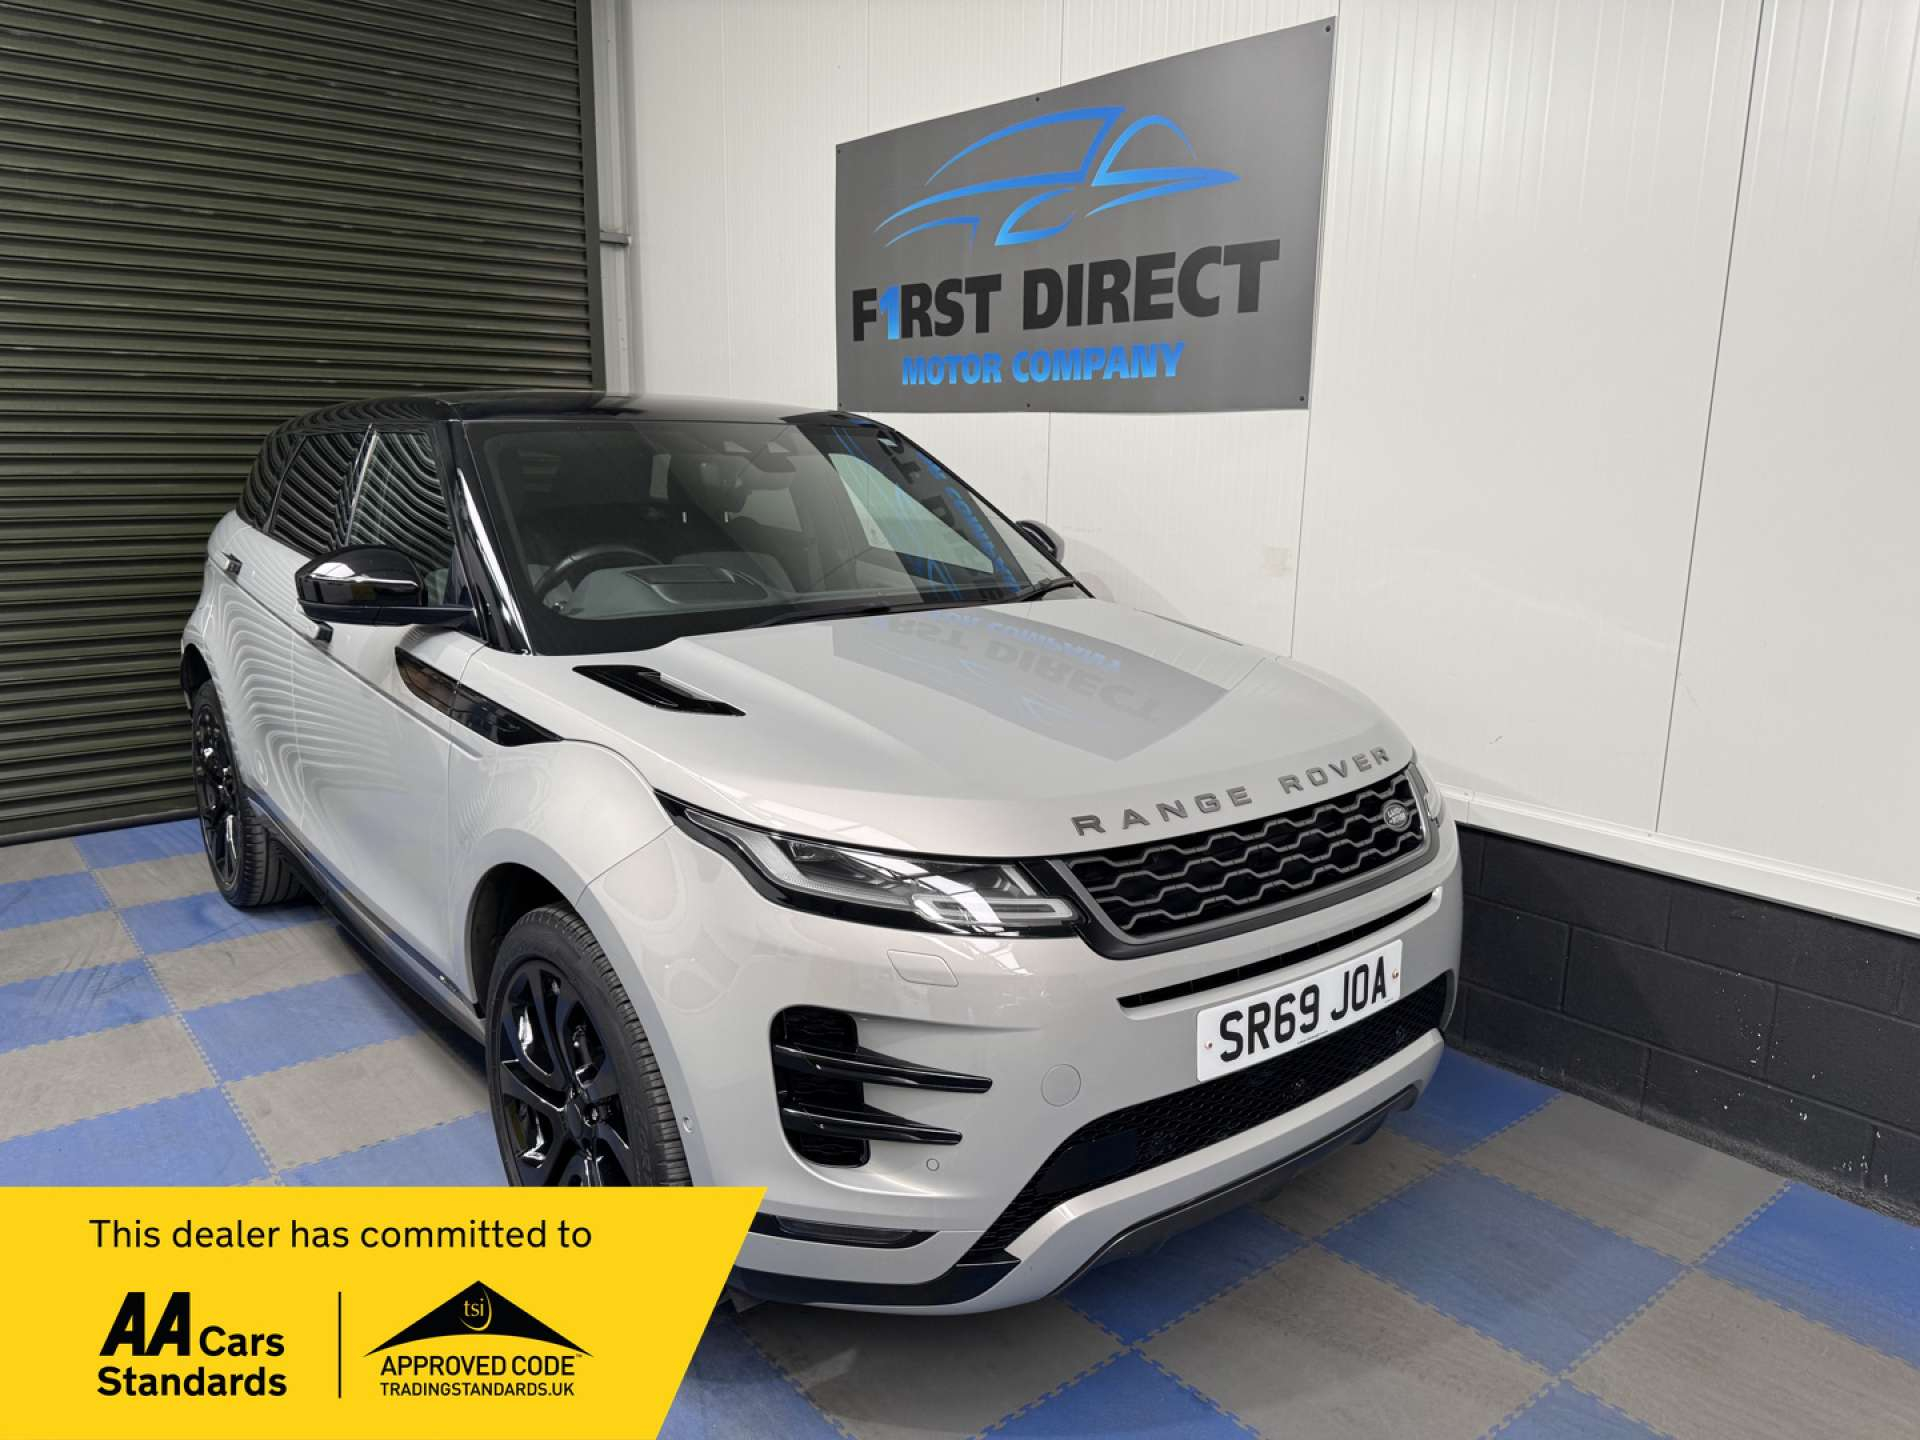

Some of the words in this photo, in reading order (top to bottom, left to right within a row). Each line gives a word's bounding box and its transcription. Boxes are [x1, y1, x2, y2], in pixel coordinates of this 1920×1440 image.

[852, 274, 1002, 342] F1RST
[1022, 239, 1281, 331] DIRECT
[902, 352, 1002, 386] MOTOR
[1012, 342, 1185, 384] COMPANY
[1070, 785, 1253, 838] RANGE
[1278, 746, 1391, 795] ROVER
[1219, 982, 1321, 1064] SR69
[1329, 955, 1388, 1022] JOA
